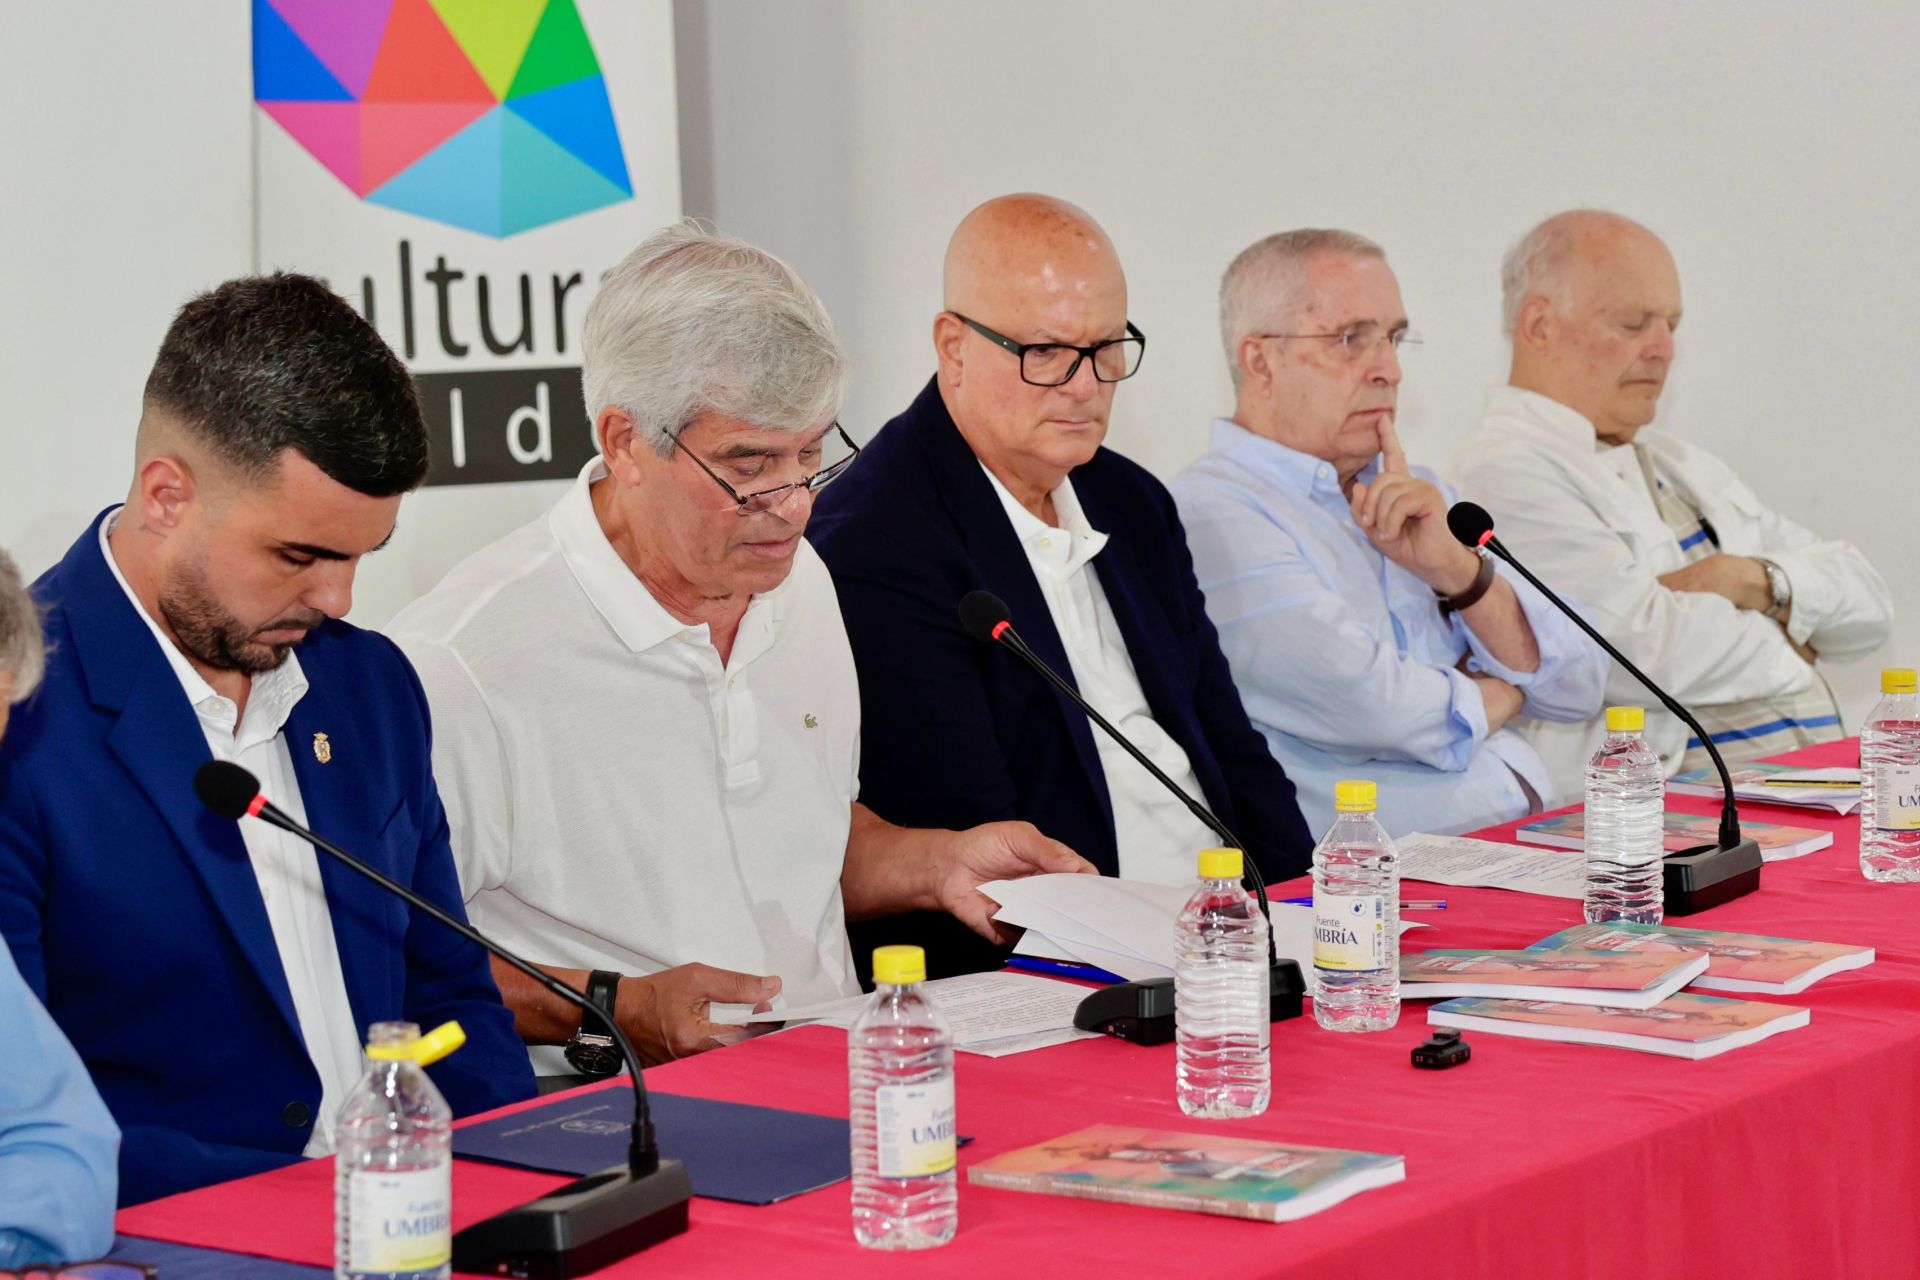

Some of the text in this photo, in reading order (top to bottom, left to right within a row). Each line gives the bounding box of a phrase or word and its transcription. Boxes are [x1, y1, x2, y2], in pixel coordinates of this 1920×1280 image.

[322, 238, 608, 358] ltur
[1898, 794, 1920, 808] UM
[1314, 926, 1358, 945] MBRÍA
[912, 1120, 955, 1144] UMB
